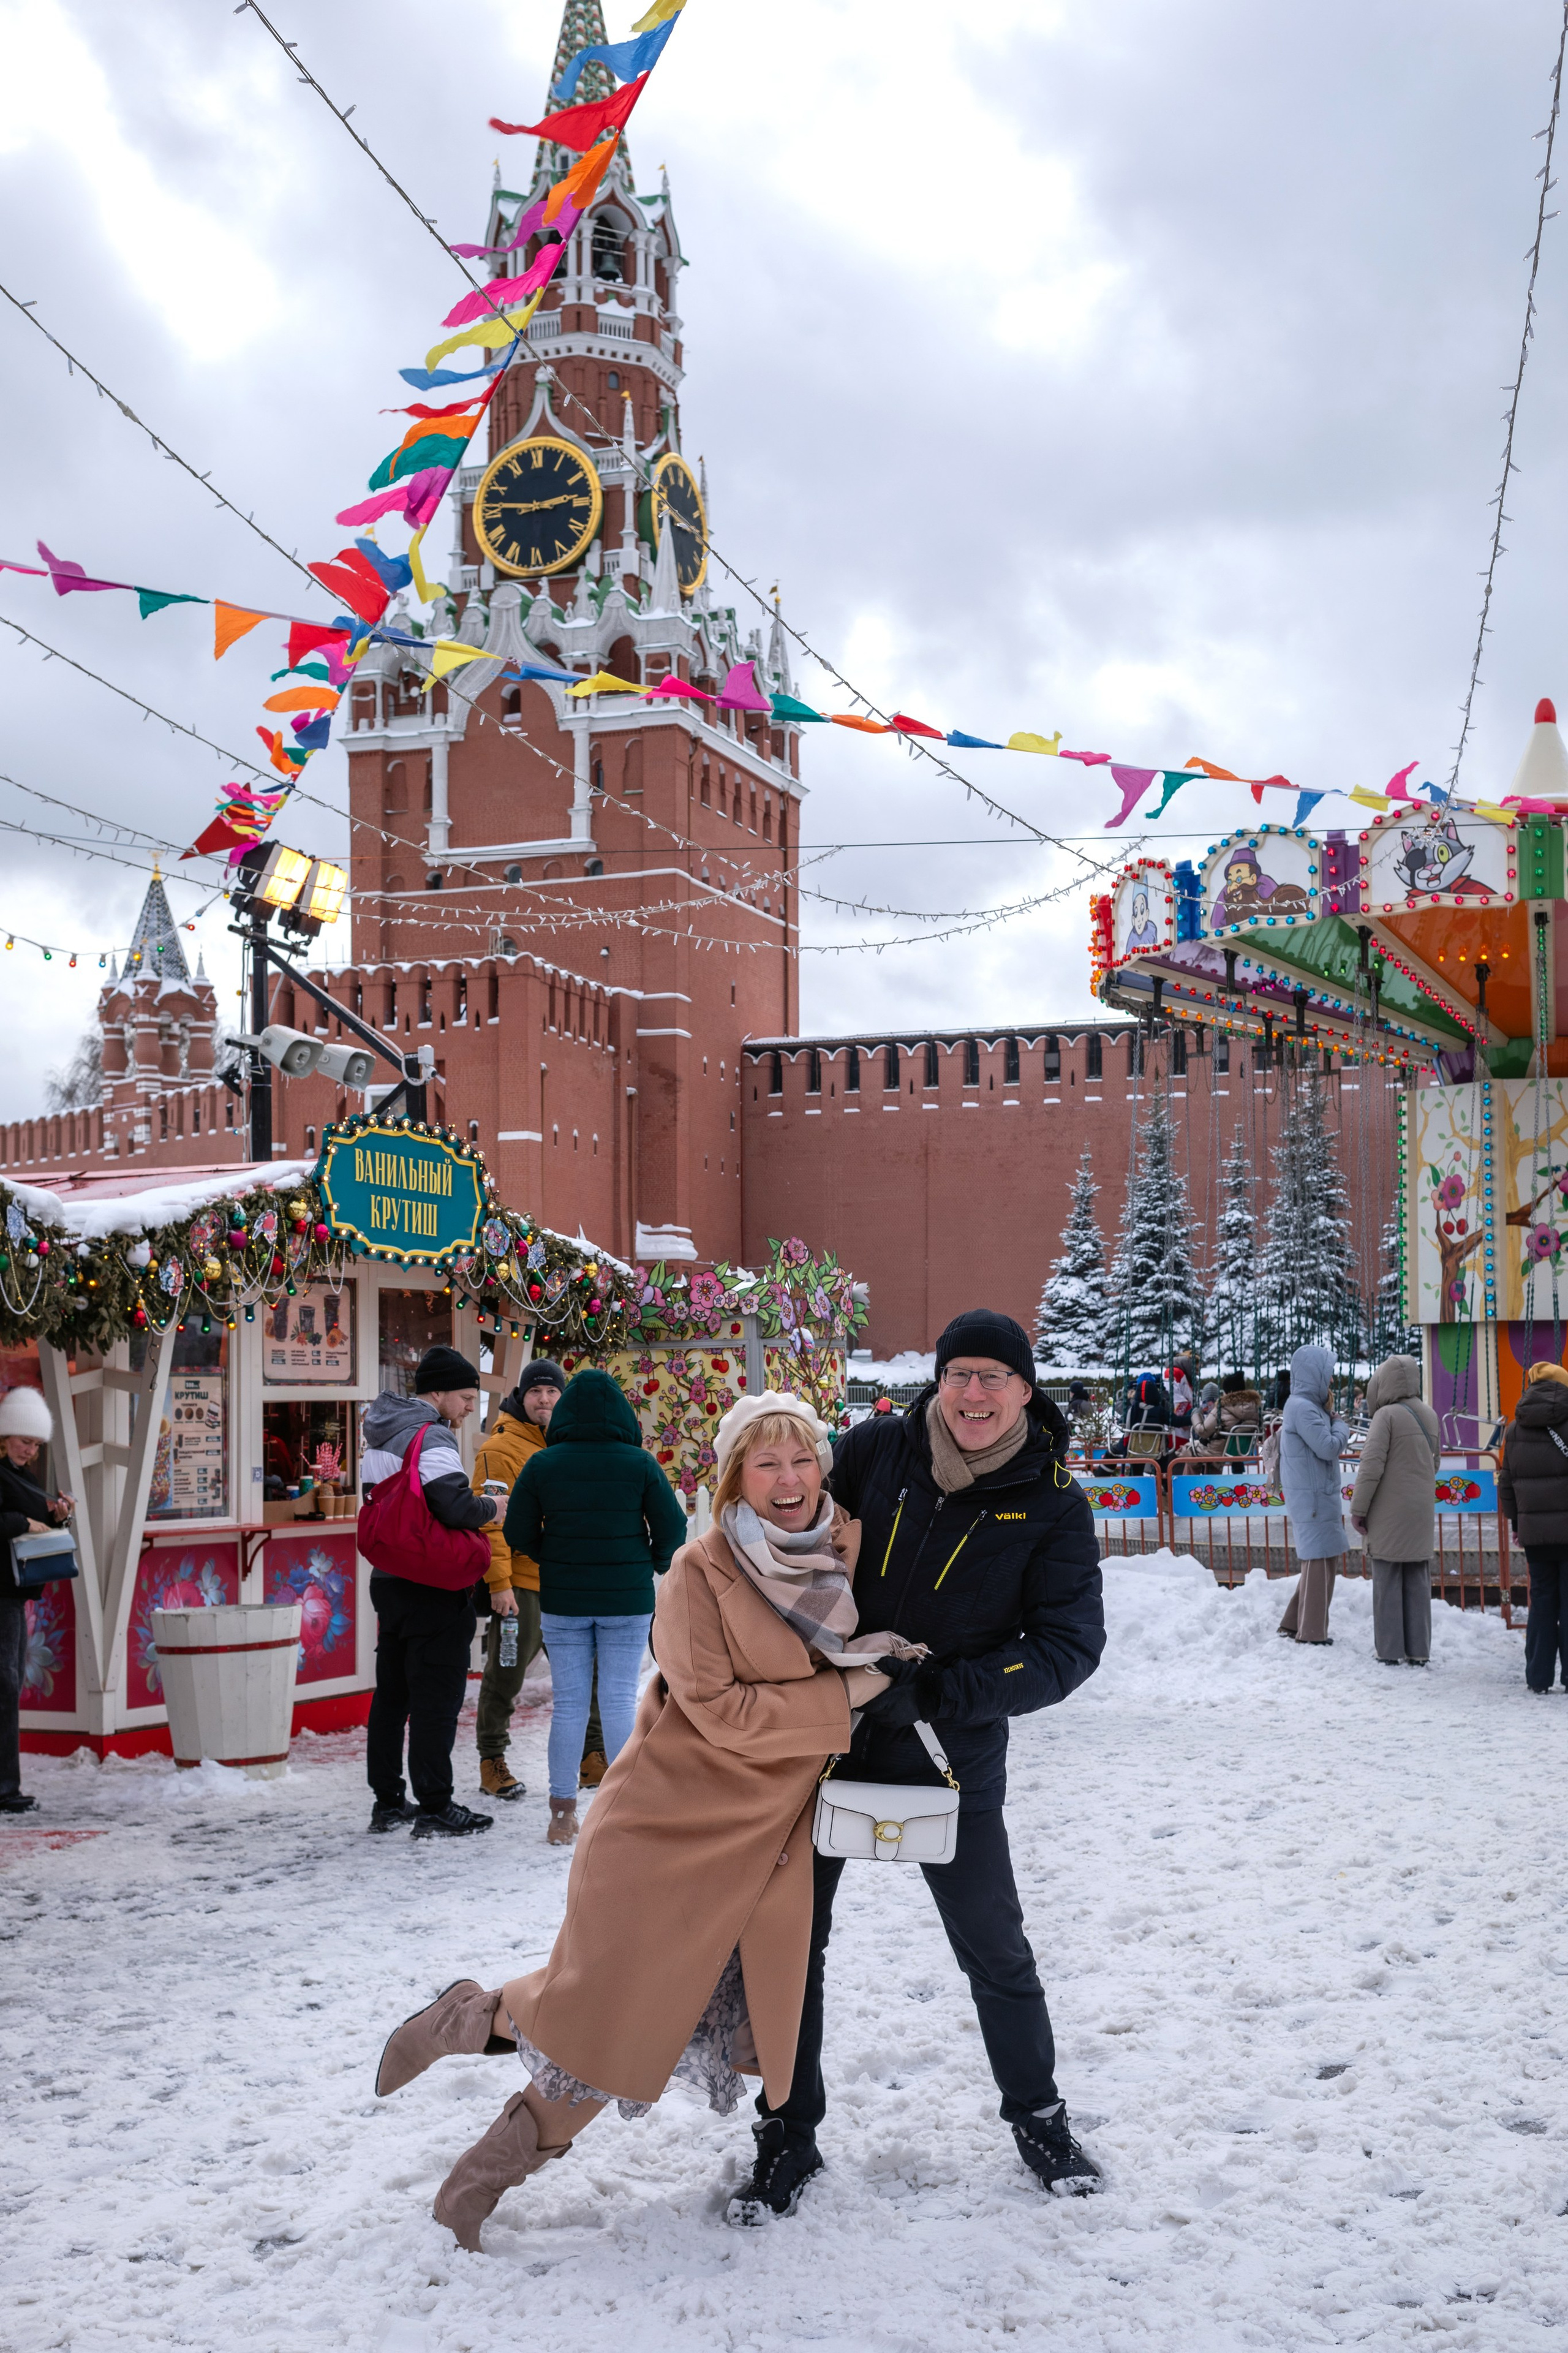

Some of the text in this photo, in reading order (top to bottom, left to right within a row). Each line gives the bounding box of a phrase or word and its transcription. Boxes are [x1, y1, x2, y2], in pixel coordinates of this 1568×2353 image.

[355, 1148, 453, 1197] ВАНИЛЬНЫЙ
[371, 1194, 439, 1237] КРУТИШ
[175, 1391, 208, 1400] КРУТИШ
[1003, 1663, 1024, 1674] SENSORTEX
